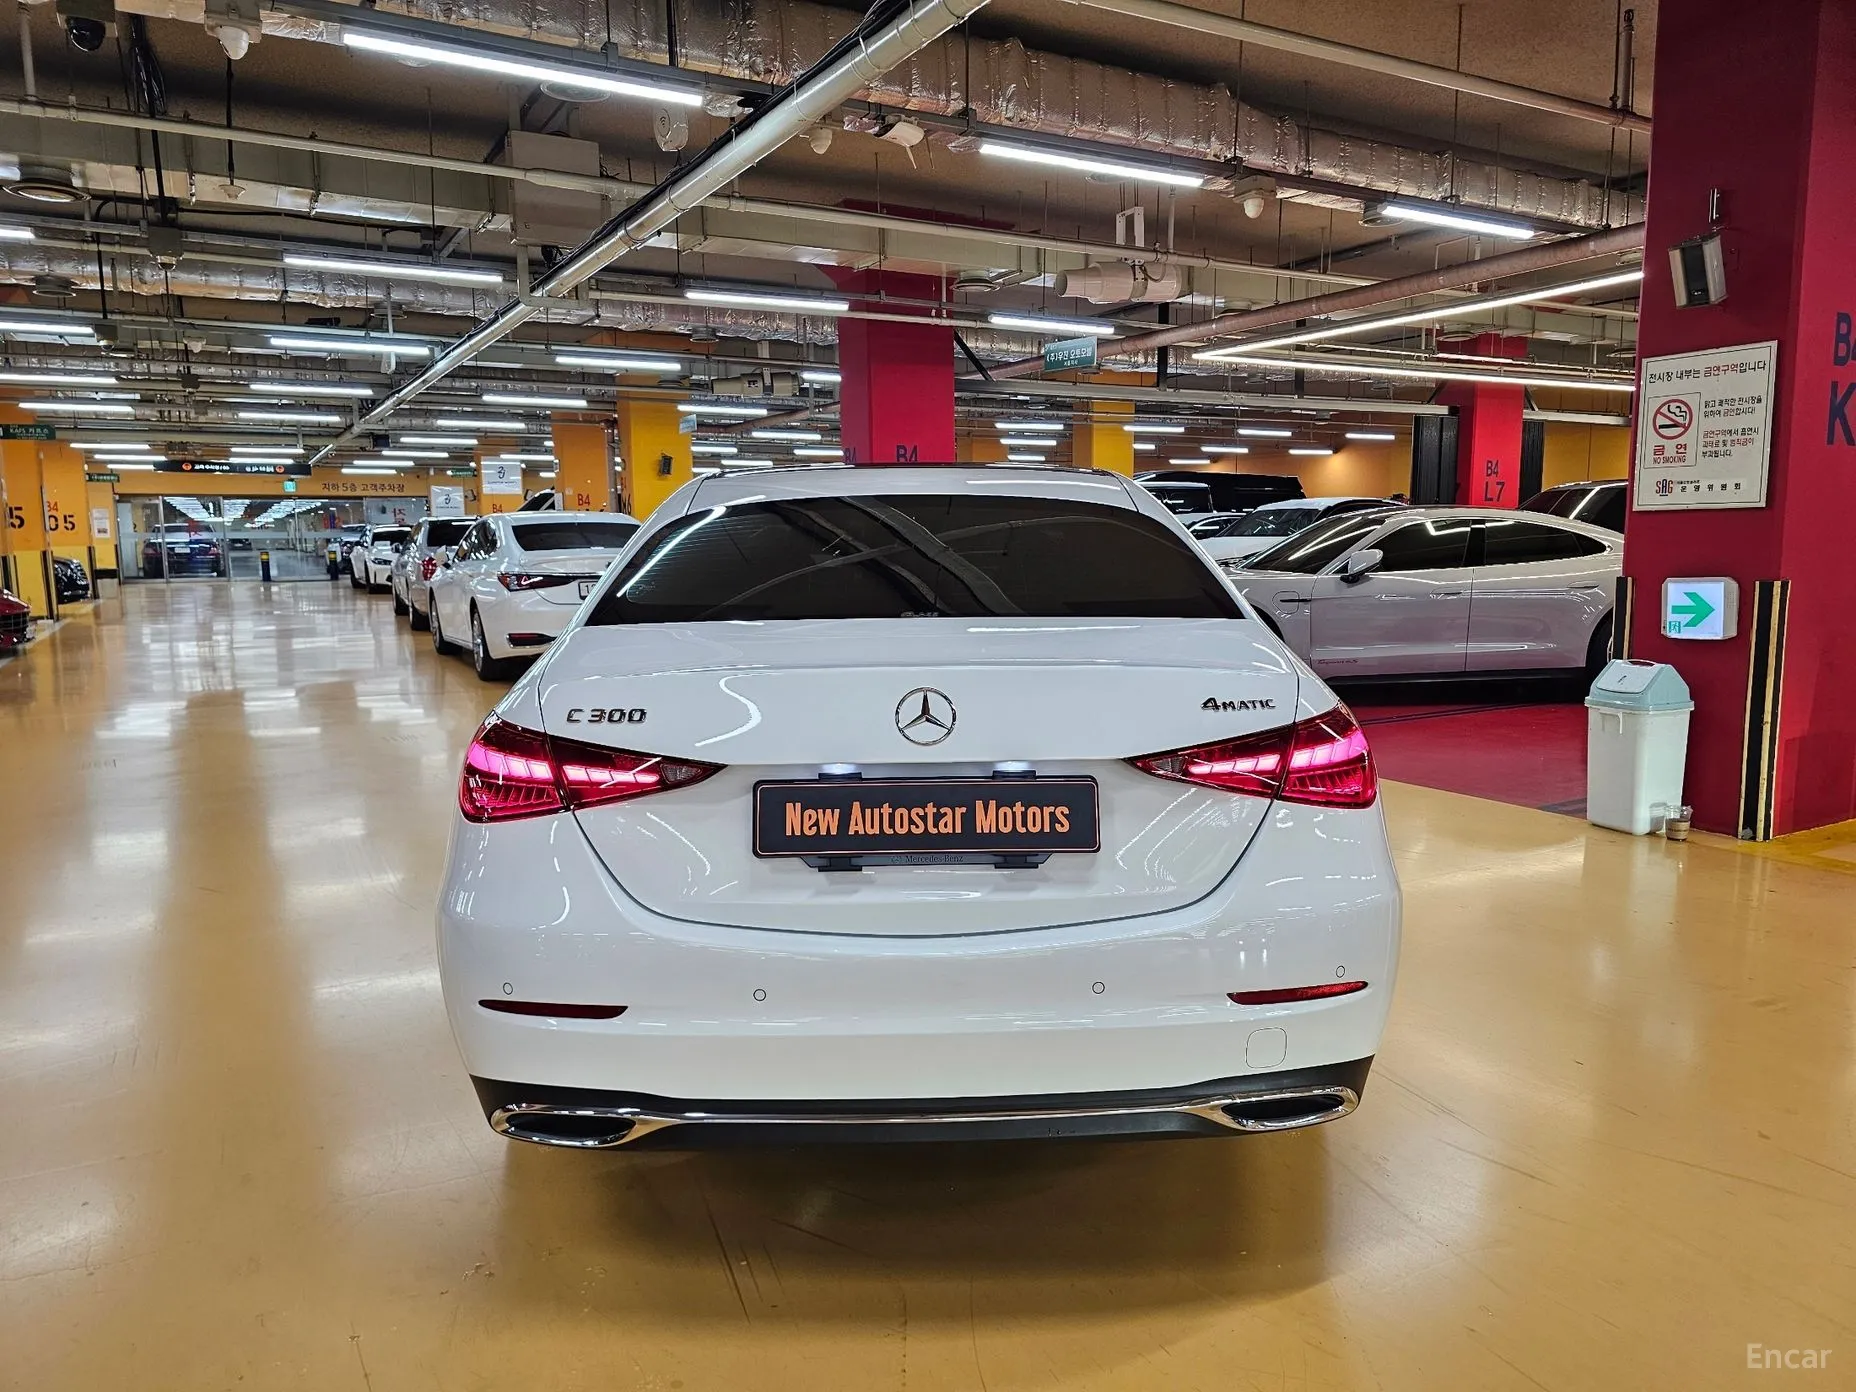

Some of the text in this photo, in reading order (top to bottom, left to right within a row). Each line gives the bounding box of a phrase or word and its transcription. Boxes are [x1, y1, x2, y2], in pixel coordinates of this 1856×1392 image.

[1648, 360, 1767, 384] 전시장 내부는 금연구역입니다
[1737, 395, 1763, 406] 전시장을
[1703, 407, 1756, 419] 위하여 금연합시다!
[1702, 426, 1759, 439] 금연구역에서 흡연시
[1702, 440, 1720, 448] 과태료
[1653, 455, 1686, 465] NO SMOKING
[1486, 459, 1499, 477] B4
[361, 483, 405, 493] 고객주차장
[1484, 481, 1505, 502] L7
[1655, 479, 1674, 495] SAG
[577, 493, 591, 506] B4
[492, 503, 503, 513] B4
[1201, 697, 1276, 711] 4MATIC
[566, 708, 647, 723] C 300
[785, 800, 1070, 836] New Autostar Motors
[905, 854, 965, 863] Mercedes-Benz
